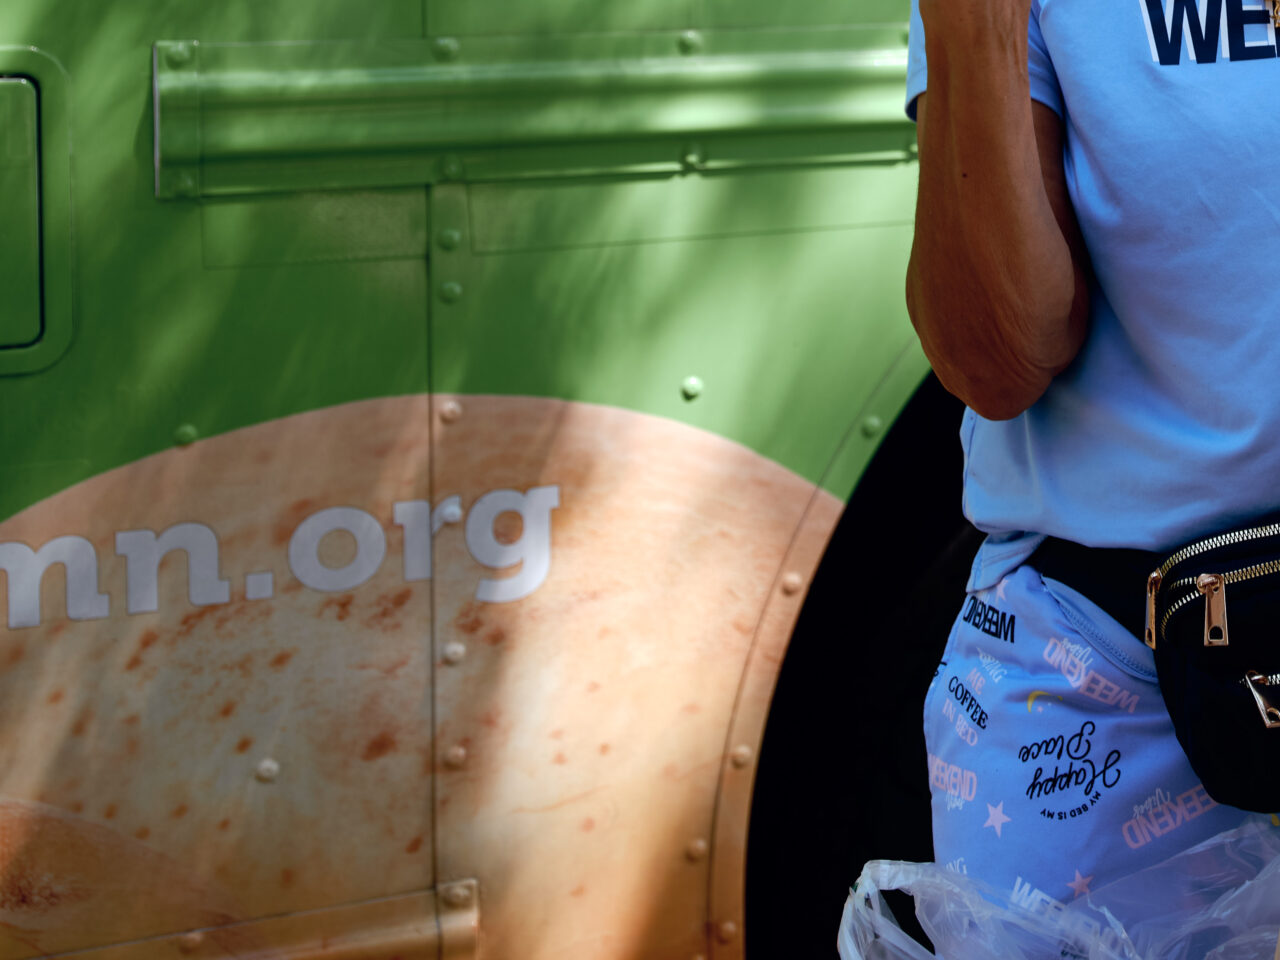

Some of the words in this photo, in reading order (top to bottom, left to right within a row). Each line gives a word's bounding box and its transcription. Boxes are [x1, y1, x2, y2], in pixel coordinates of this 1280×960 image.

[963, 595, 1015, 644] WEEKEND
[1042, 637, 1140, 714] WEEKEND
[942, 698, 956, 723] IN
[955, 714, 978, 746] BED
[948, 676, 988, 730] COFFEE
[1018, 721, 1095, 763] Place
[1026, 750, 1121, 800] Happy
[1089, 791, 1101, 806] MY
[1040, 808, 1055, 820] MY
[1057, 811, 1066, 820] IS
[1070, 804, 1088, 818] BED
[1121, 783, 1219, 851] EEKEND
